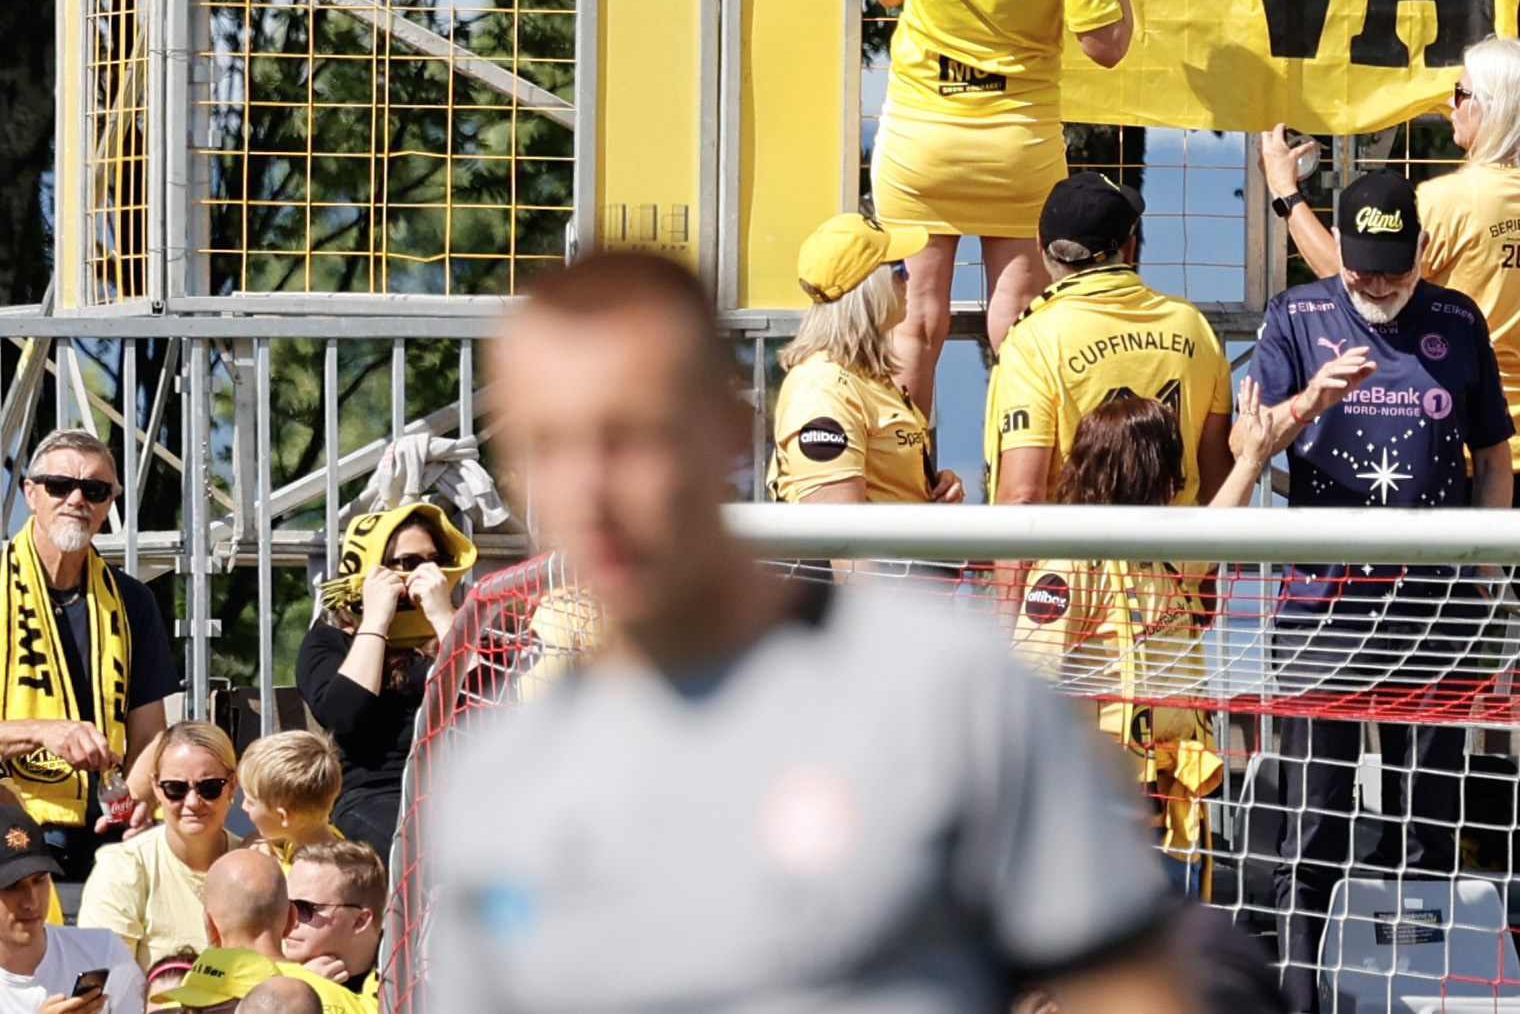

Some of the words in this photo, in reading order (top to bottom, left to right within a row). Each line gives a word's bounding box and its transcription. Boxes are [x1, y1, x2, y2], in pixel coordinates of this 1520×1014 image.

[1356, 206, 1404, 234] Glimt
[1298, 301, 1335, 313] Elkem
[1443, 303, 1475, 324] Elkem
[1068, 331, 1196, 374] CUPFINALEN
[1342, 387, 1420, 405] areBank
[1343, 404, 1421, 417] NORD-NORGE
[800, 429, 846, 444] altibox
